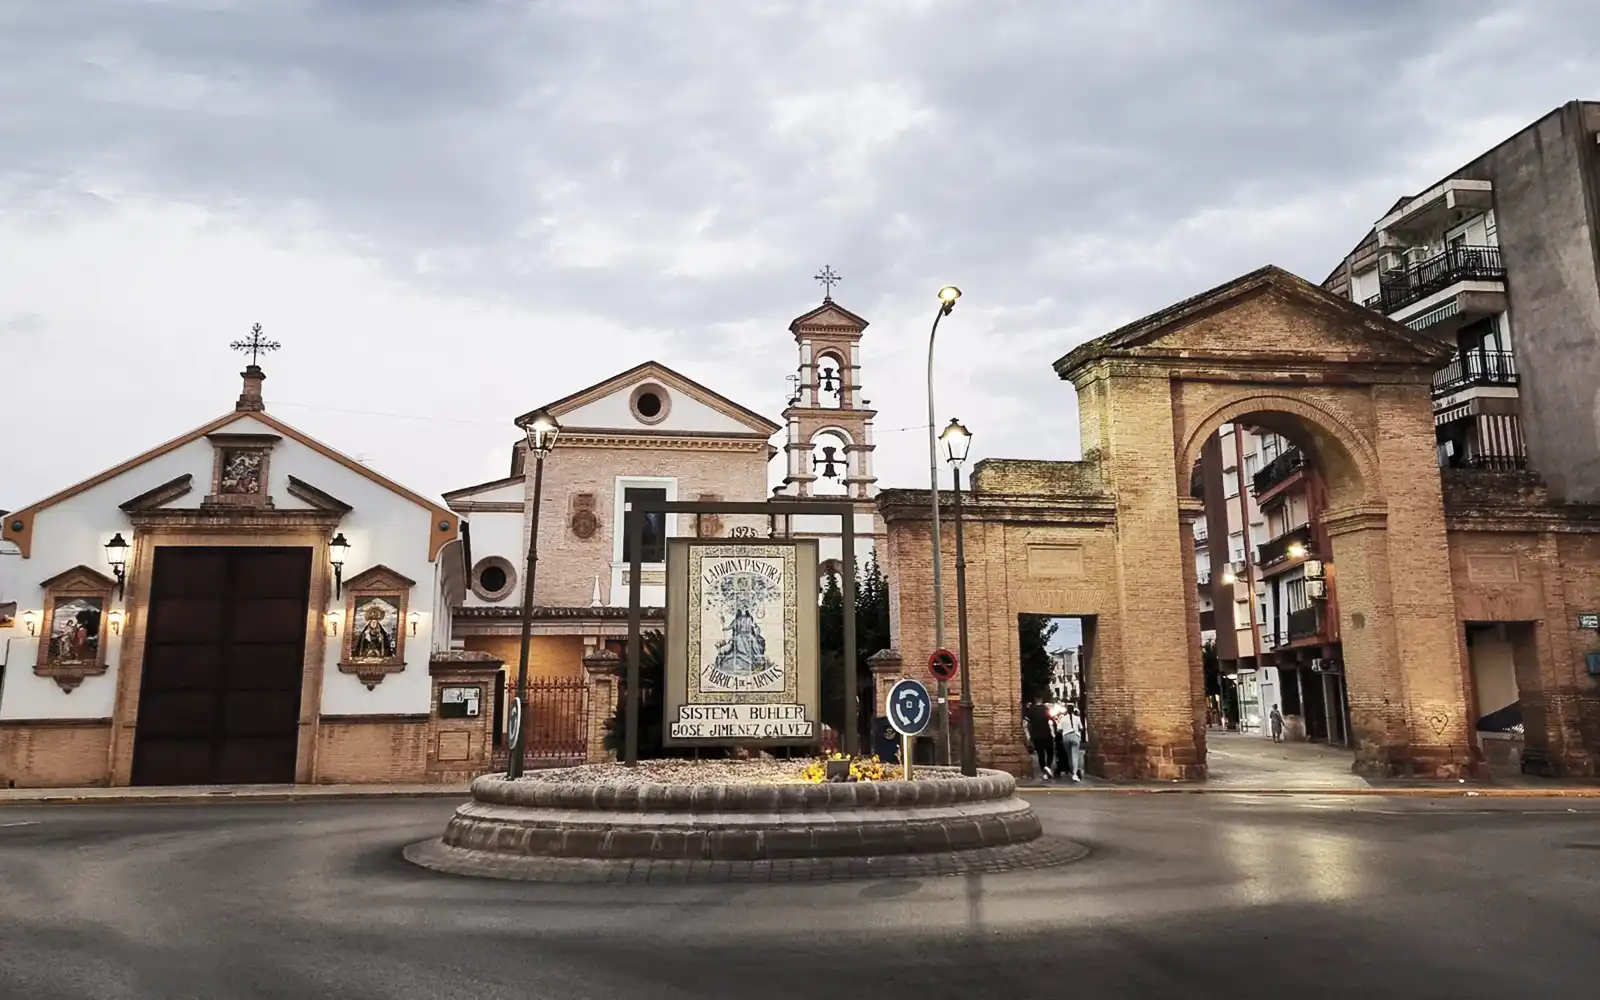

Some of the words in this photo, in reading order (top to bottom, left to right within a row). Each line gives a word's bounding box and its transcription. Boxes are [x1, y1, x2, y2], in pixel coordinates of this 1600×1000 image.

[731, 526, 756, 538] 1925
[703, 568, 718, 585] LA
[744, 559, 782, 585] PASTORA
[681, 707, 738, 720] SISTEMA
[750, 707, 803, 720] BUHLER
